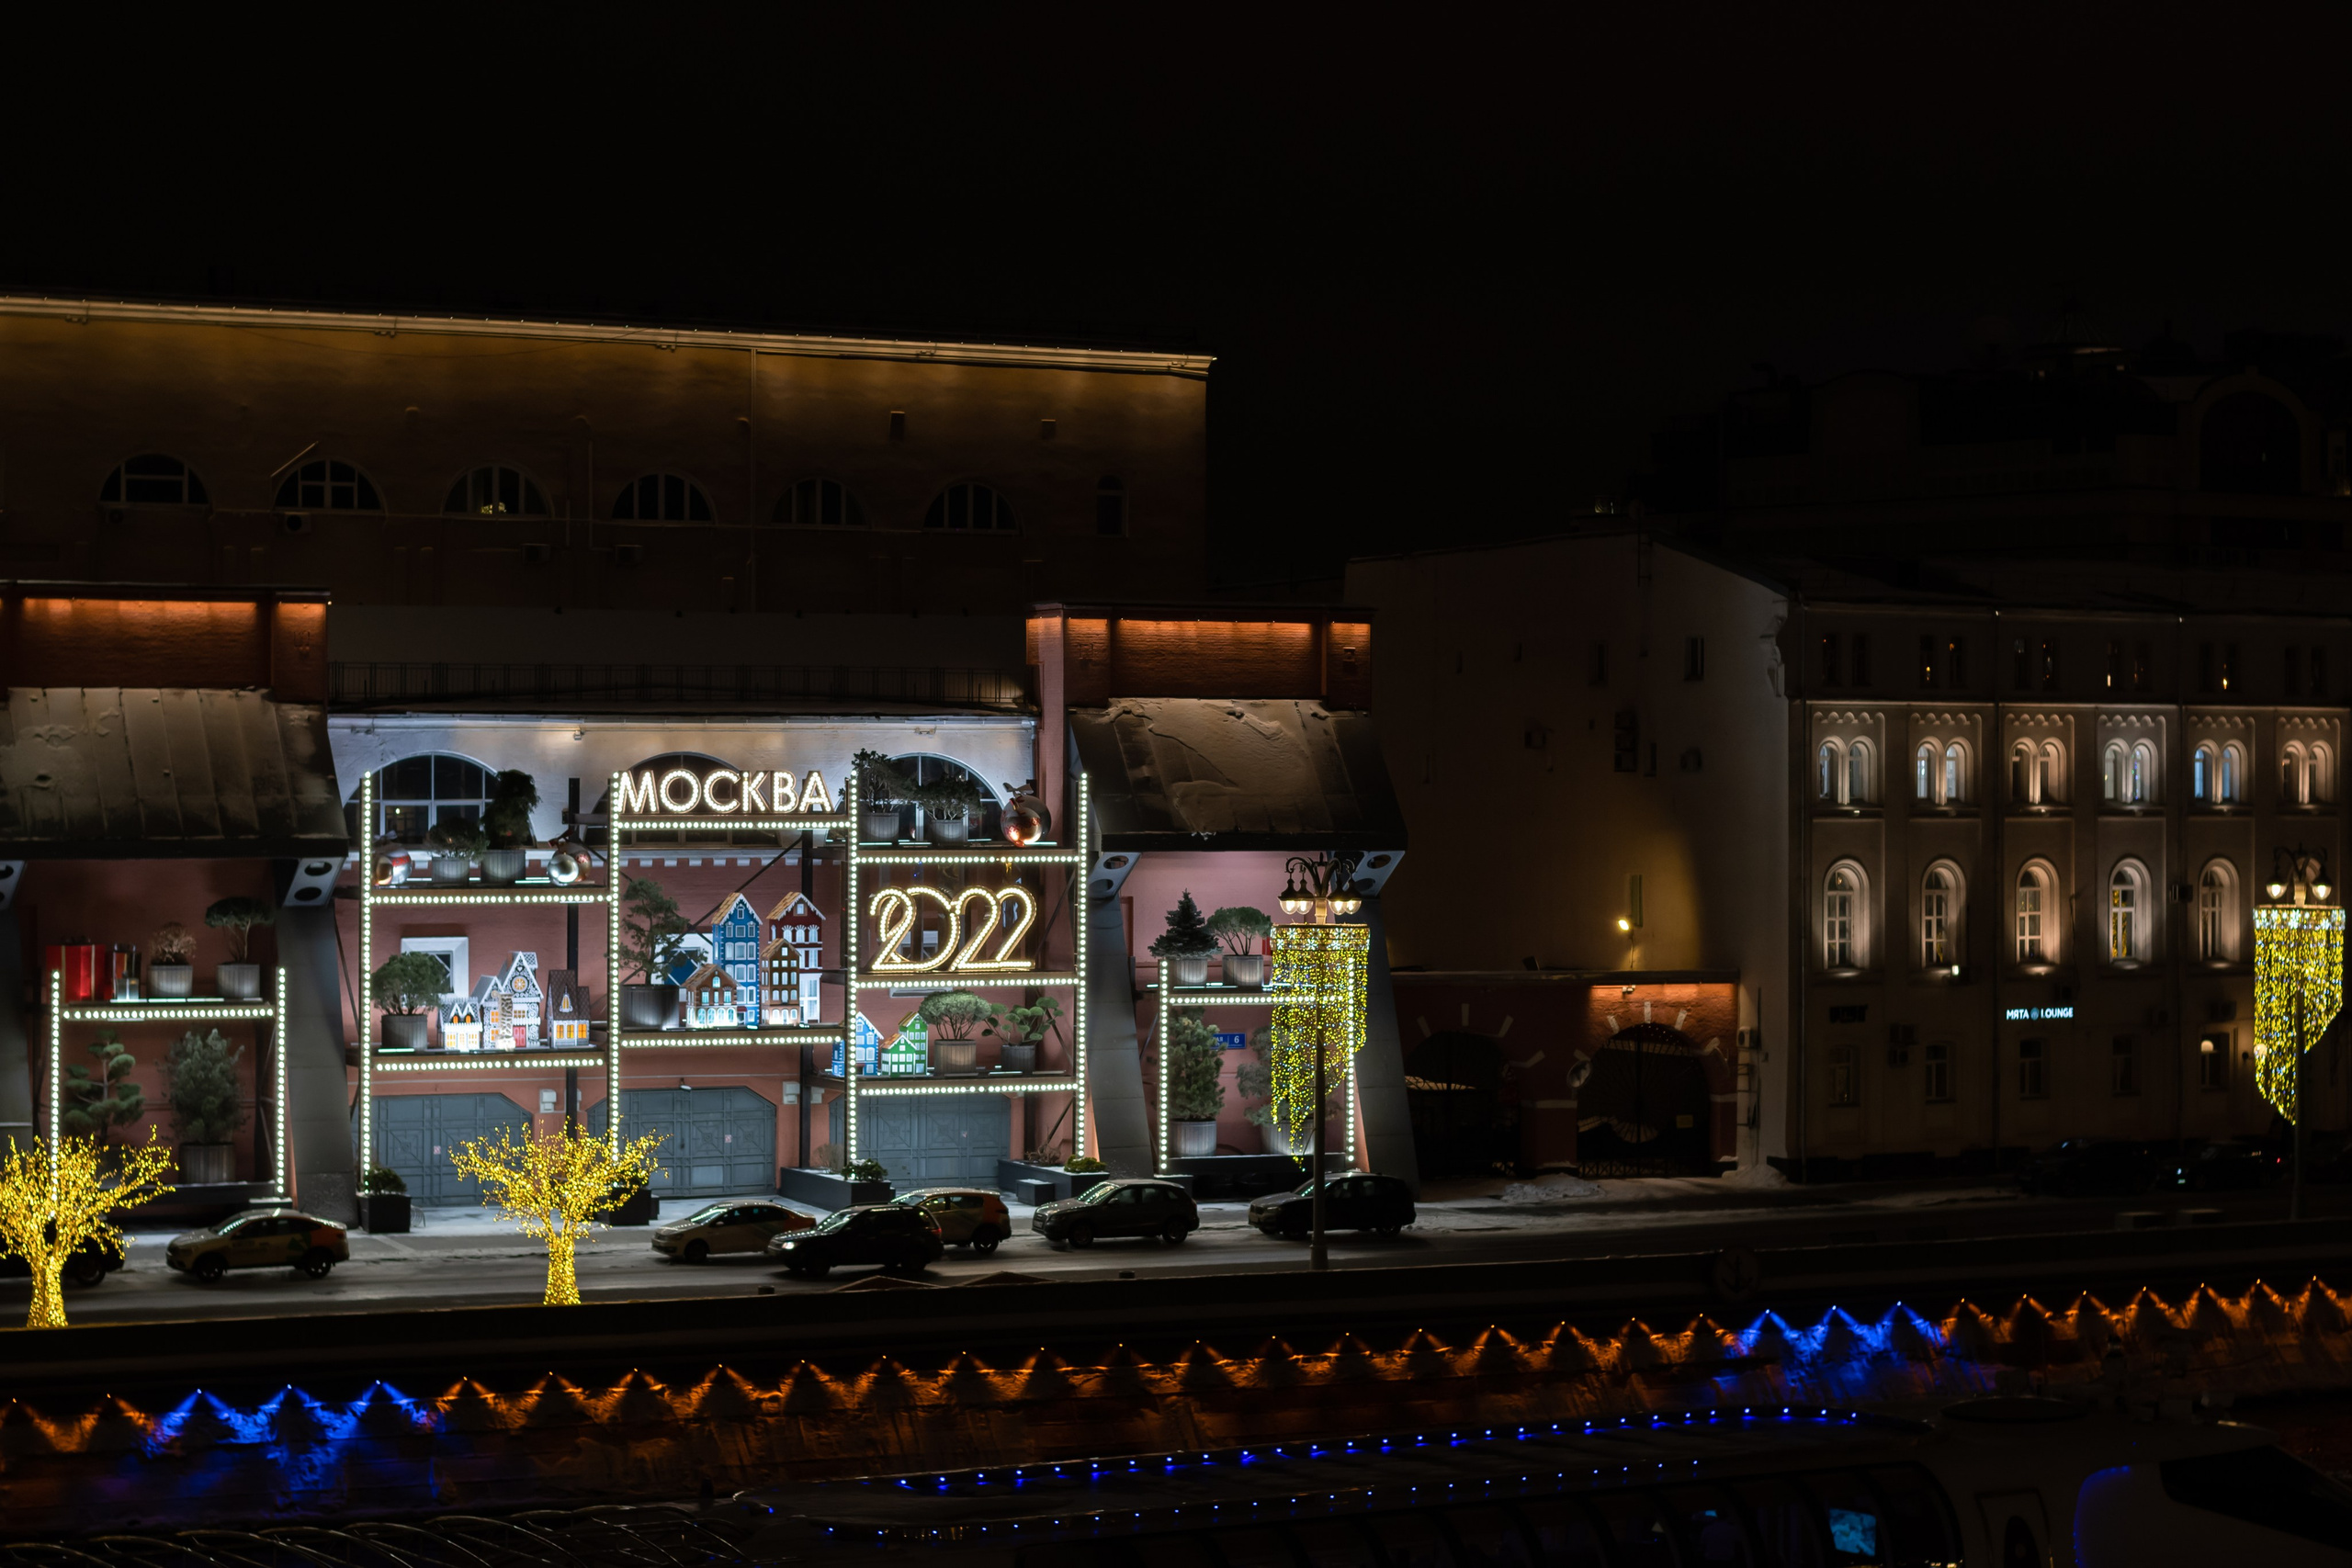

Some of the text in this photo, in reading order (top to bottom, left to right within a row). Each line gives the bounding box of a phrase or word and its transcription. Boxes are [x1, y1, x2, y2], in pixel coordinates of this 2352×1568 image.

[617, 768, 835, 814] МОСКВА
[870, 885, 1036, 972] 2022
[2006, 1007, 2074, 1021] МЯТА LOUNGE
[1234, 1035, 1240, 1043] 6
